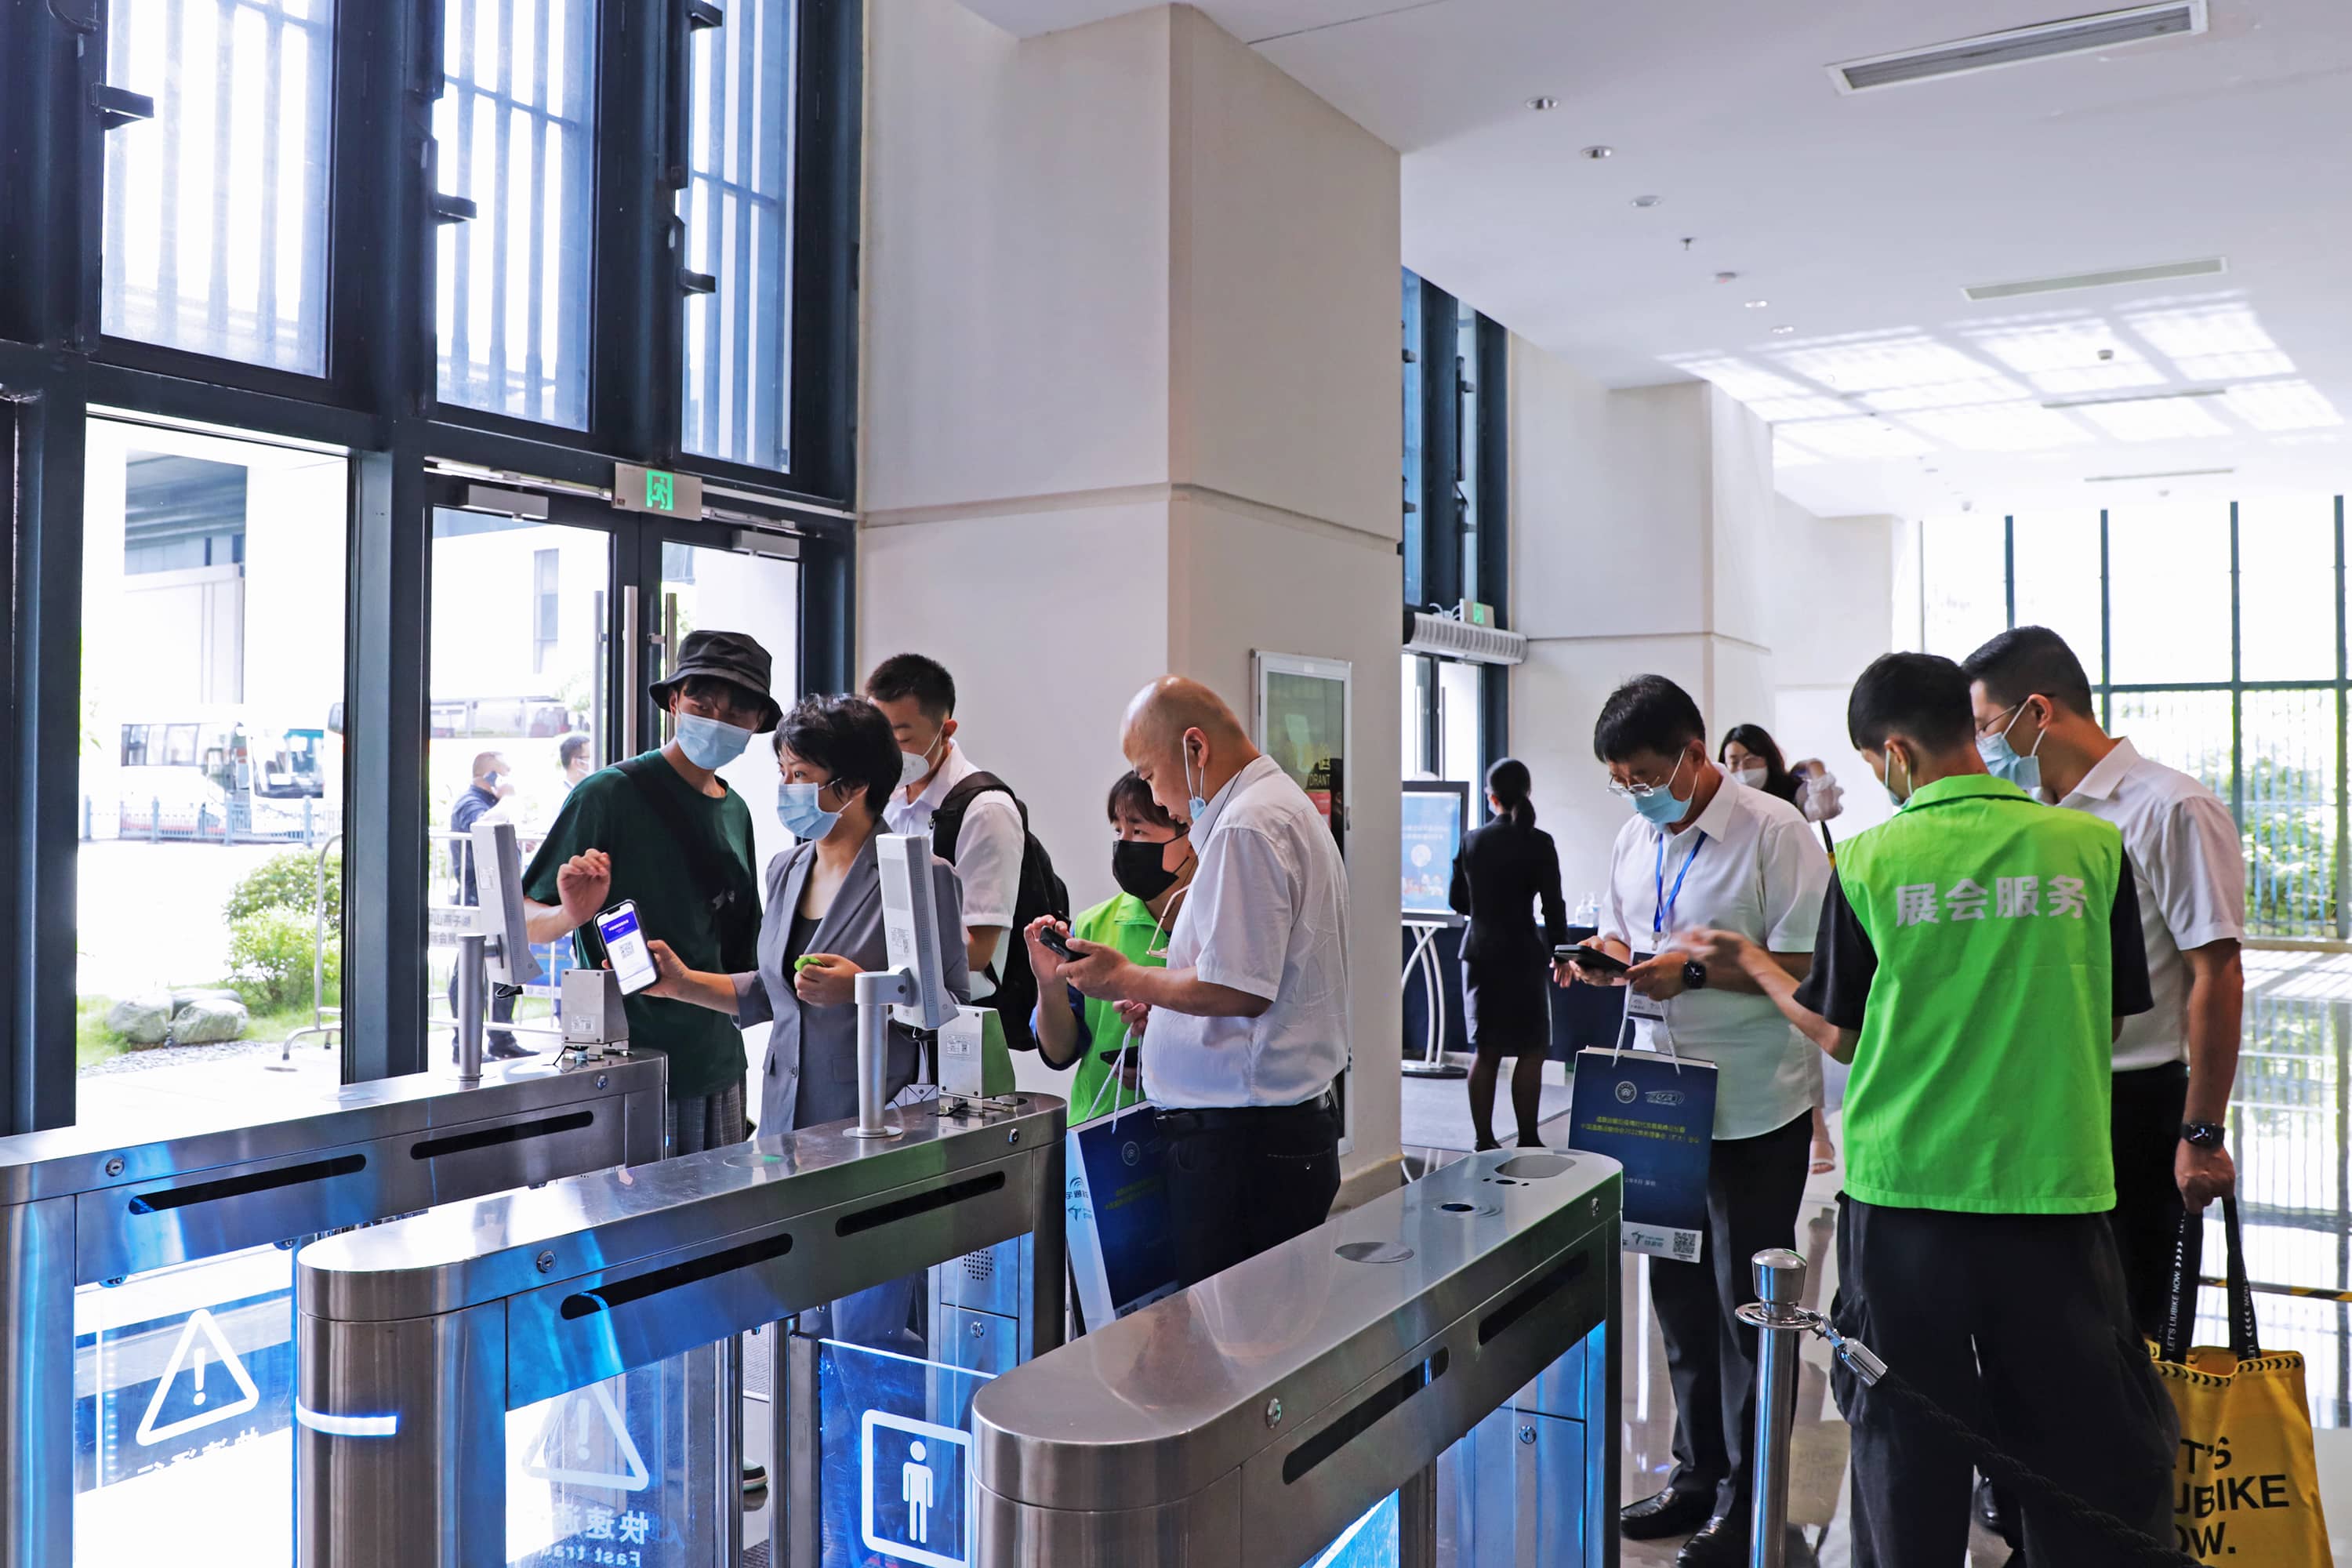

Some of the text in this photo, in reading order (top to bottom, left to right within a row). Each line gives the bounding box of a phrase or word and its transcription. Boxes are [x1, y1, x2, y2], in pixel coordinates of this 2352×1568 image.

[1895, 874, 2089, 928] 展会服务
[2180, 1436, 2233, 1475] T'S
[2174, 1474, 2290, 1519] UBIKE
